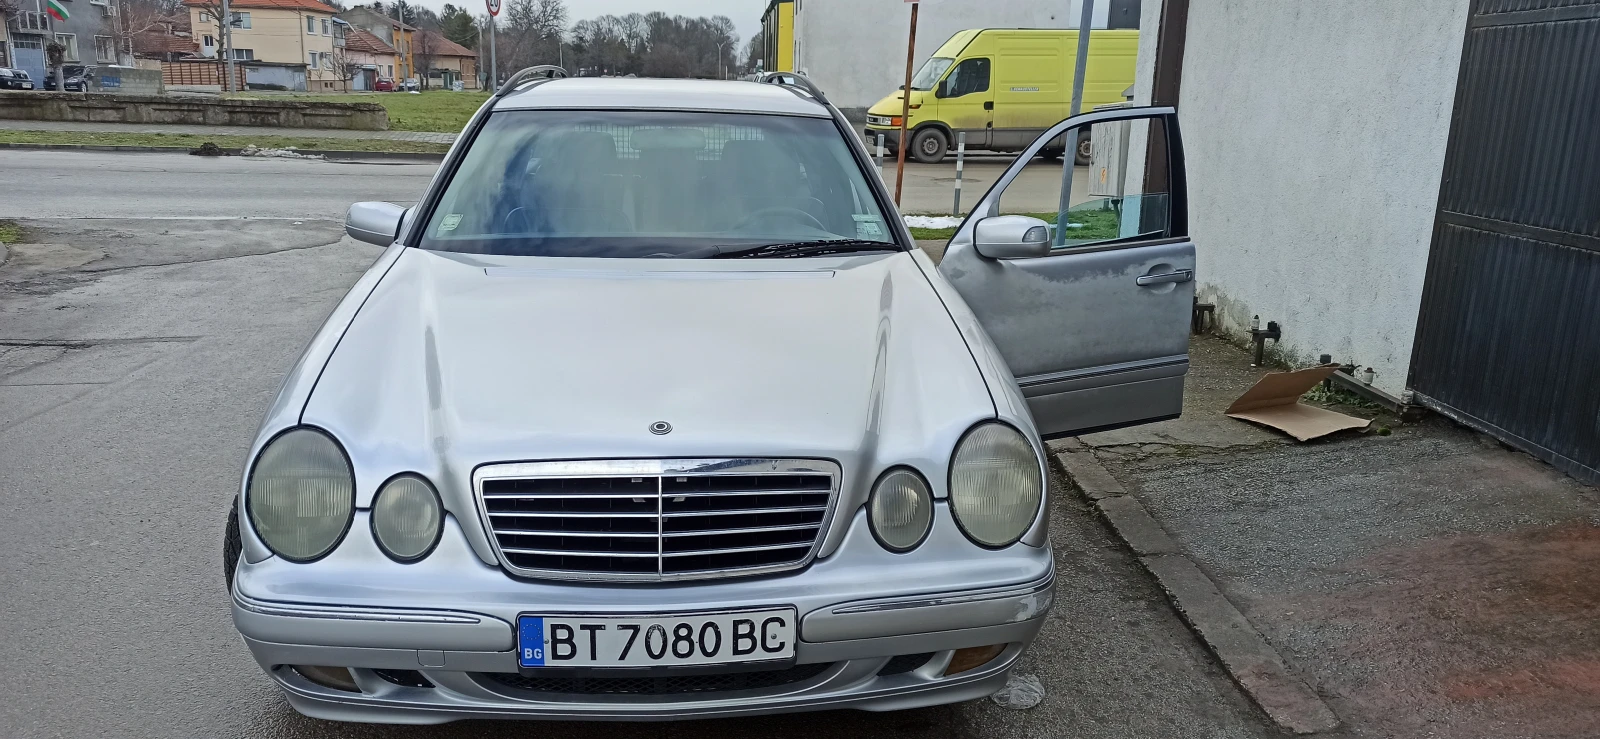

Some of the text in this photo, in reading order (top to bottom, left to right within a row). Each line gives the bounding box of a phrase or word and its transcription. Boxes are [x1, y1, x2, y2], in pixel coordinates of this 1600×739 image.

[549, 616, 786, 661] BT 7080 BC
[524, 648, 542, 659] BG
